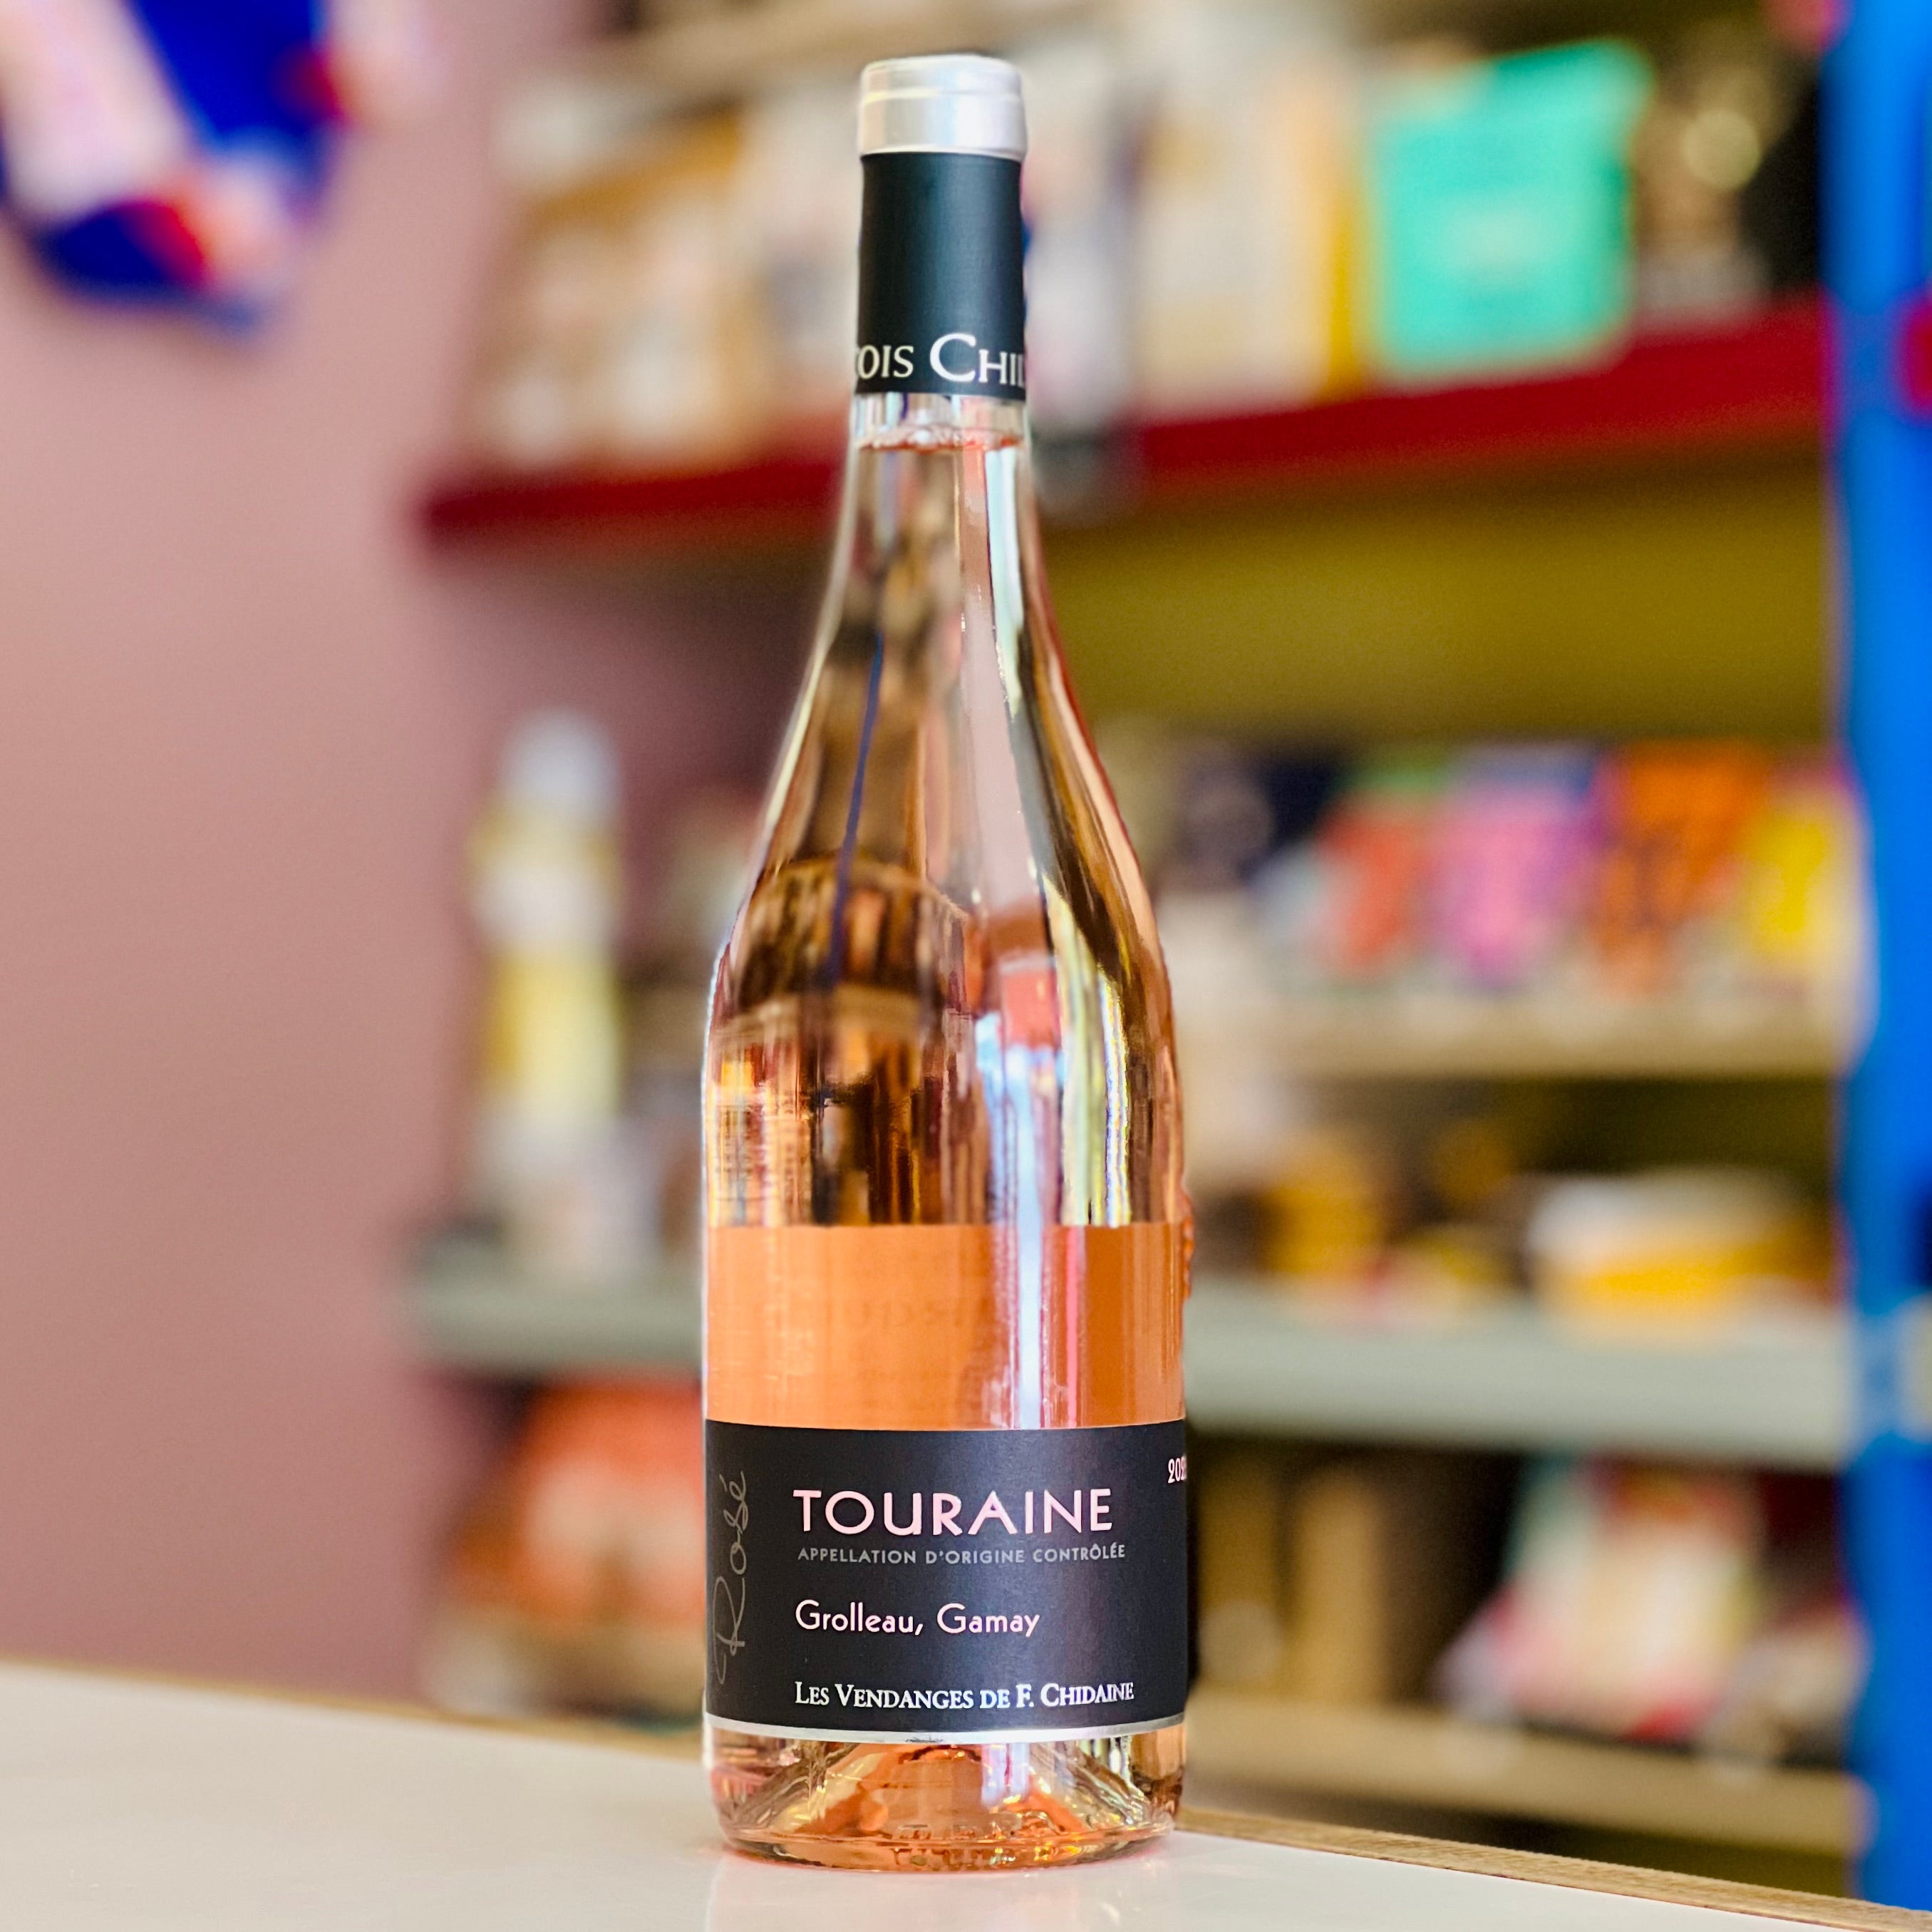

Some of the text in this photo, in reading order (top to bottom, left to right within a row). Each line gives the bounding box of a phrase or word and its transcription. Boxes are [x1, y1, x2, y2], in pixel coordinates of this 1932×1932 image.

[856, 345, 914, 380] OIS
[792, 1488, 1112, 1536] TOURAINE
[797, 1542, 1125, 1564] APPELLATION D'ORIGINE CONTRÔLÉE
[713, 1470, 749, 1685] Rosé
[795, 1598, 1040, 1638] Grolleau, Gamay
[794, 1680, 1135, 1710] LES VENDANGES DE F. CHIDAINE
